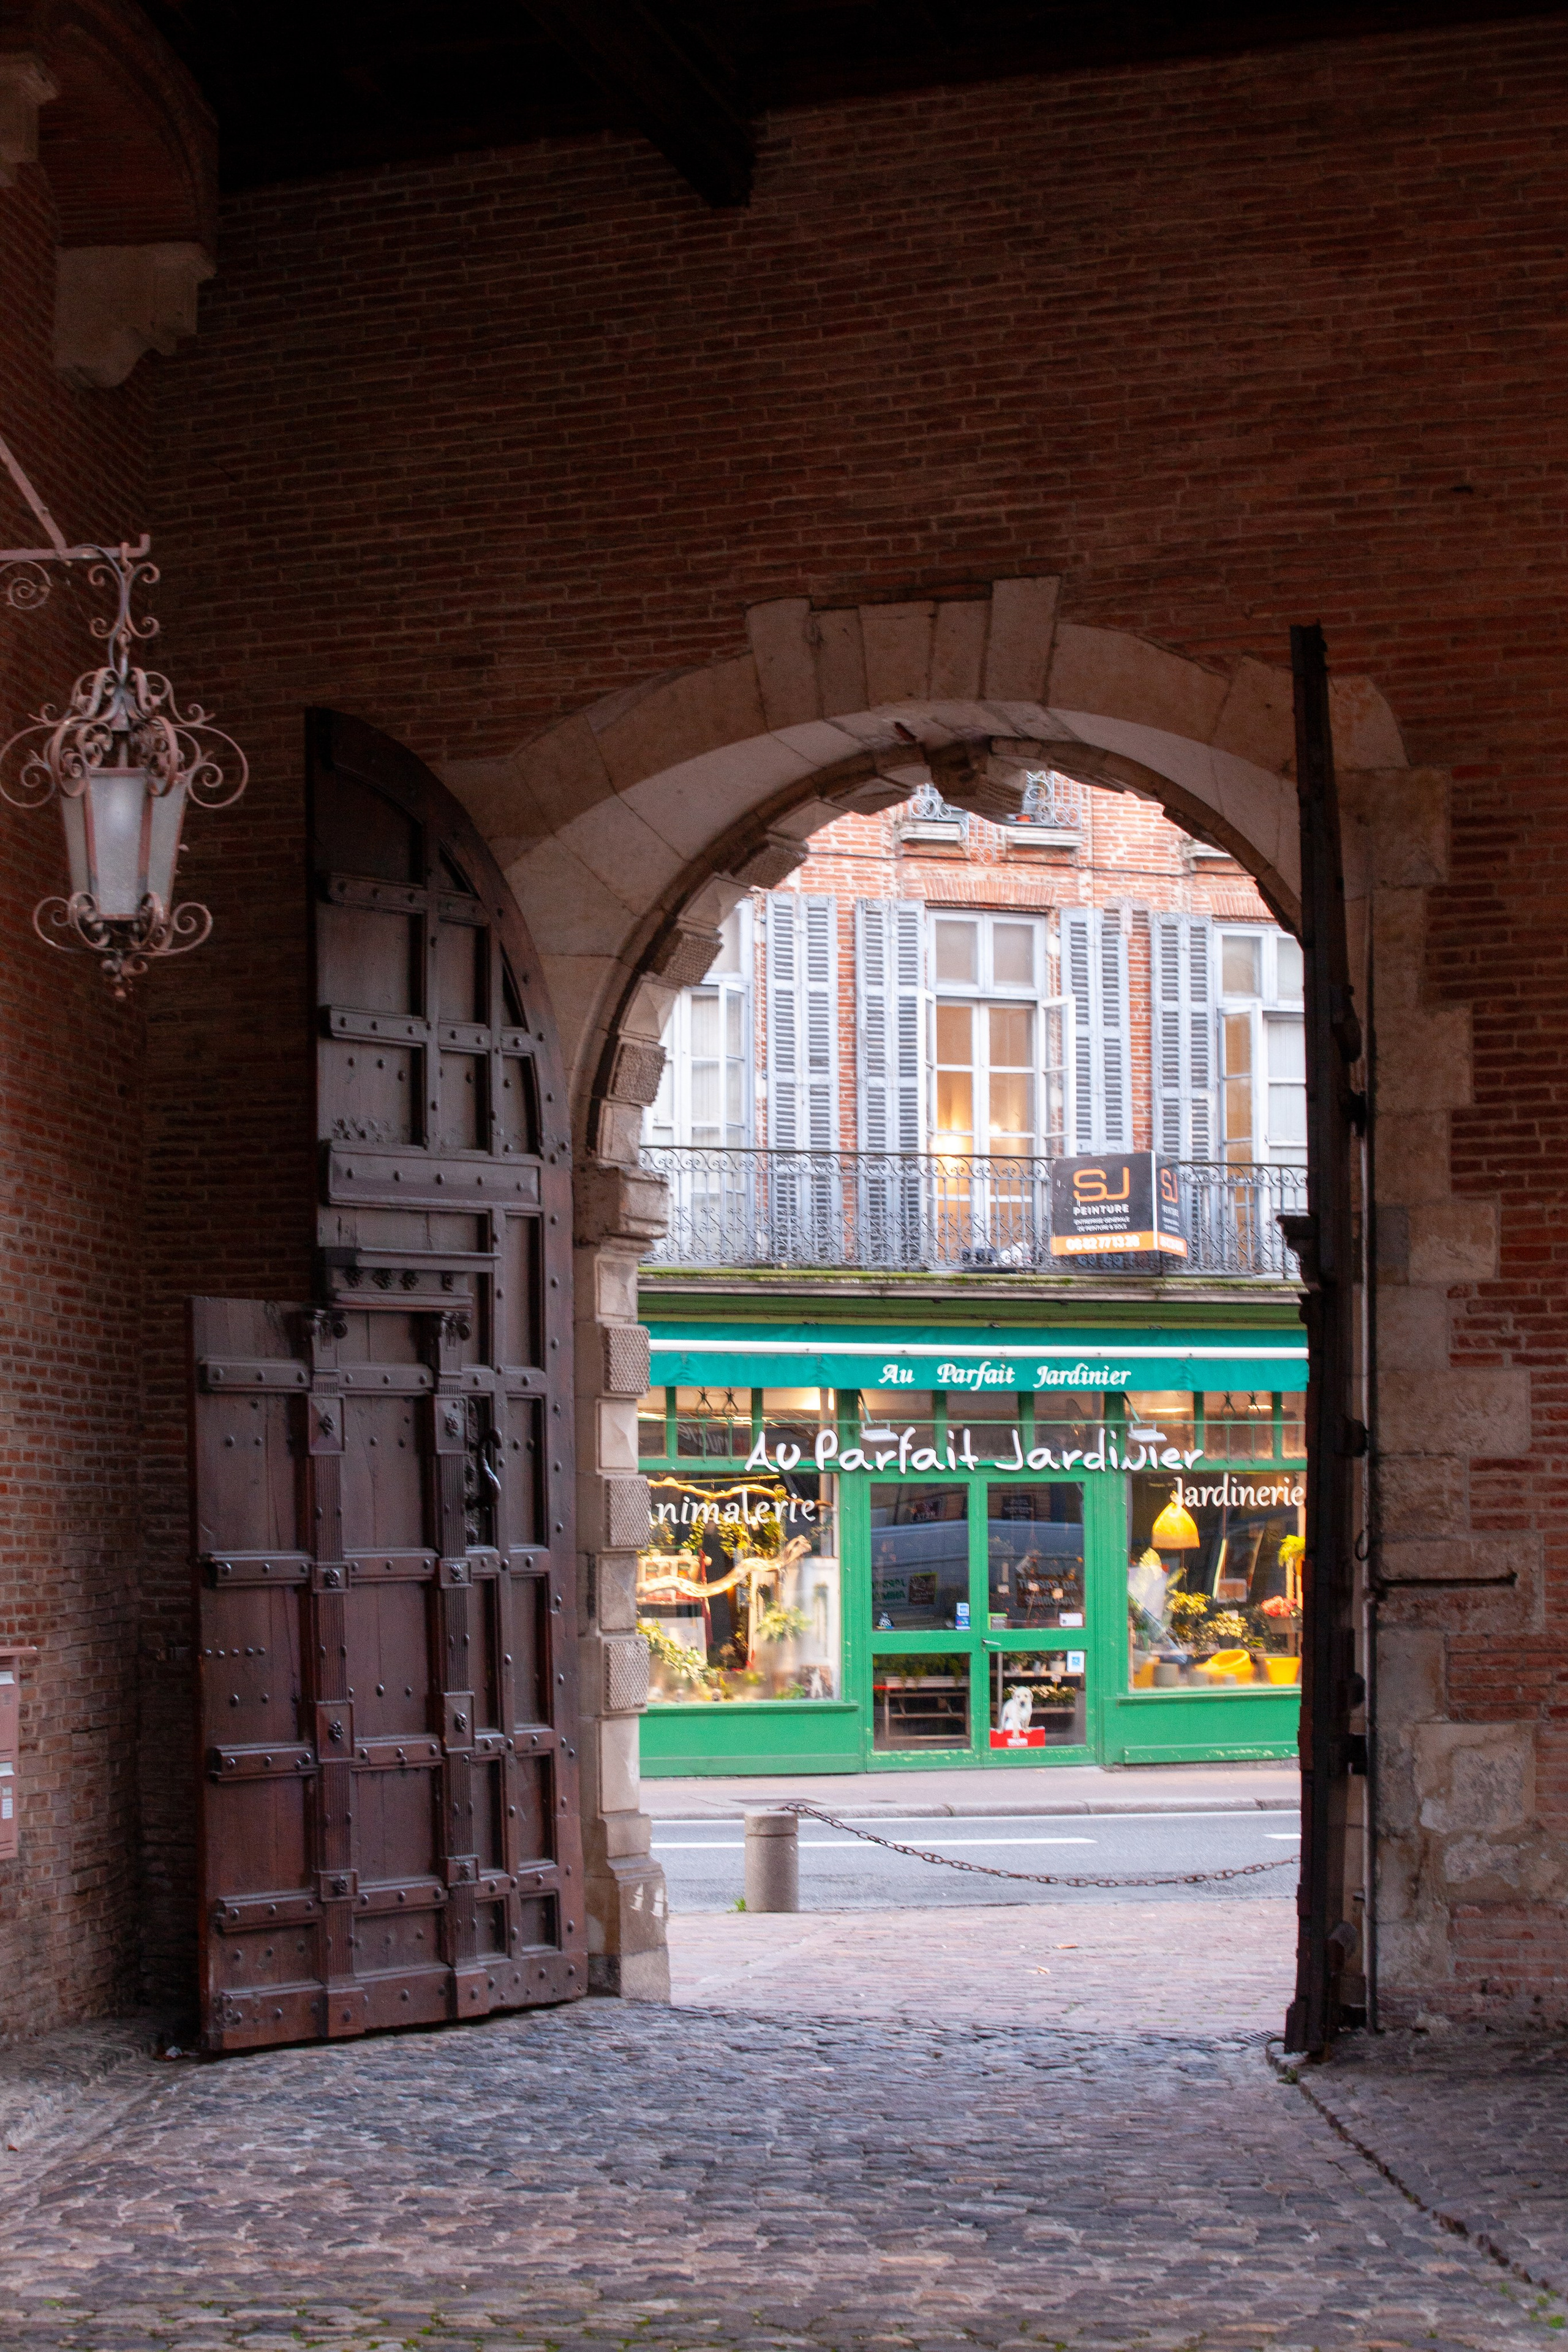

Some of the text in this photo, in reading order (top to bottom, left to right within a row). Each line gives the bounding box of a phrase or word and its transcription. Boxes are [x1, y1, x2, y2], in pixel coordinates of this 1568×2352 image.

[1073, 1166, 1130, 1202] SJ
[1160, 1167, 1178, 1204] SJ
[1072, 1204, 1129, 1216] PEINTURE
[1097, 1236, 1112, 1249] 77
[878, 1360, 1132, 1391] Au Parfait Jardinier
[744, 1431, 801, 1472] Au
[815, 1426, 979, 1474] Parfait
[995, 1427, 1204, 1472] Jardinier
[649, 1486, 816, 1525] nimalerie
[1171, 1471, 1305, 1507] Jardinerie
